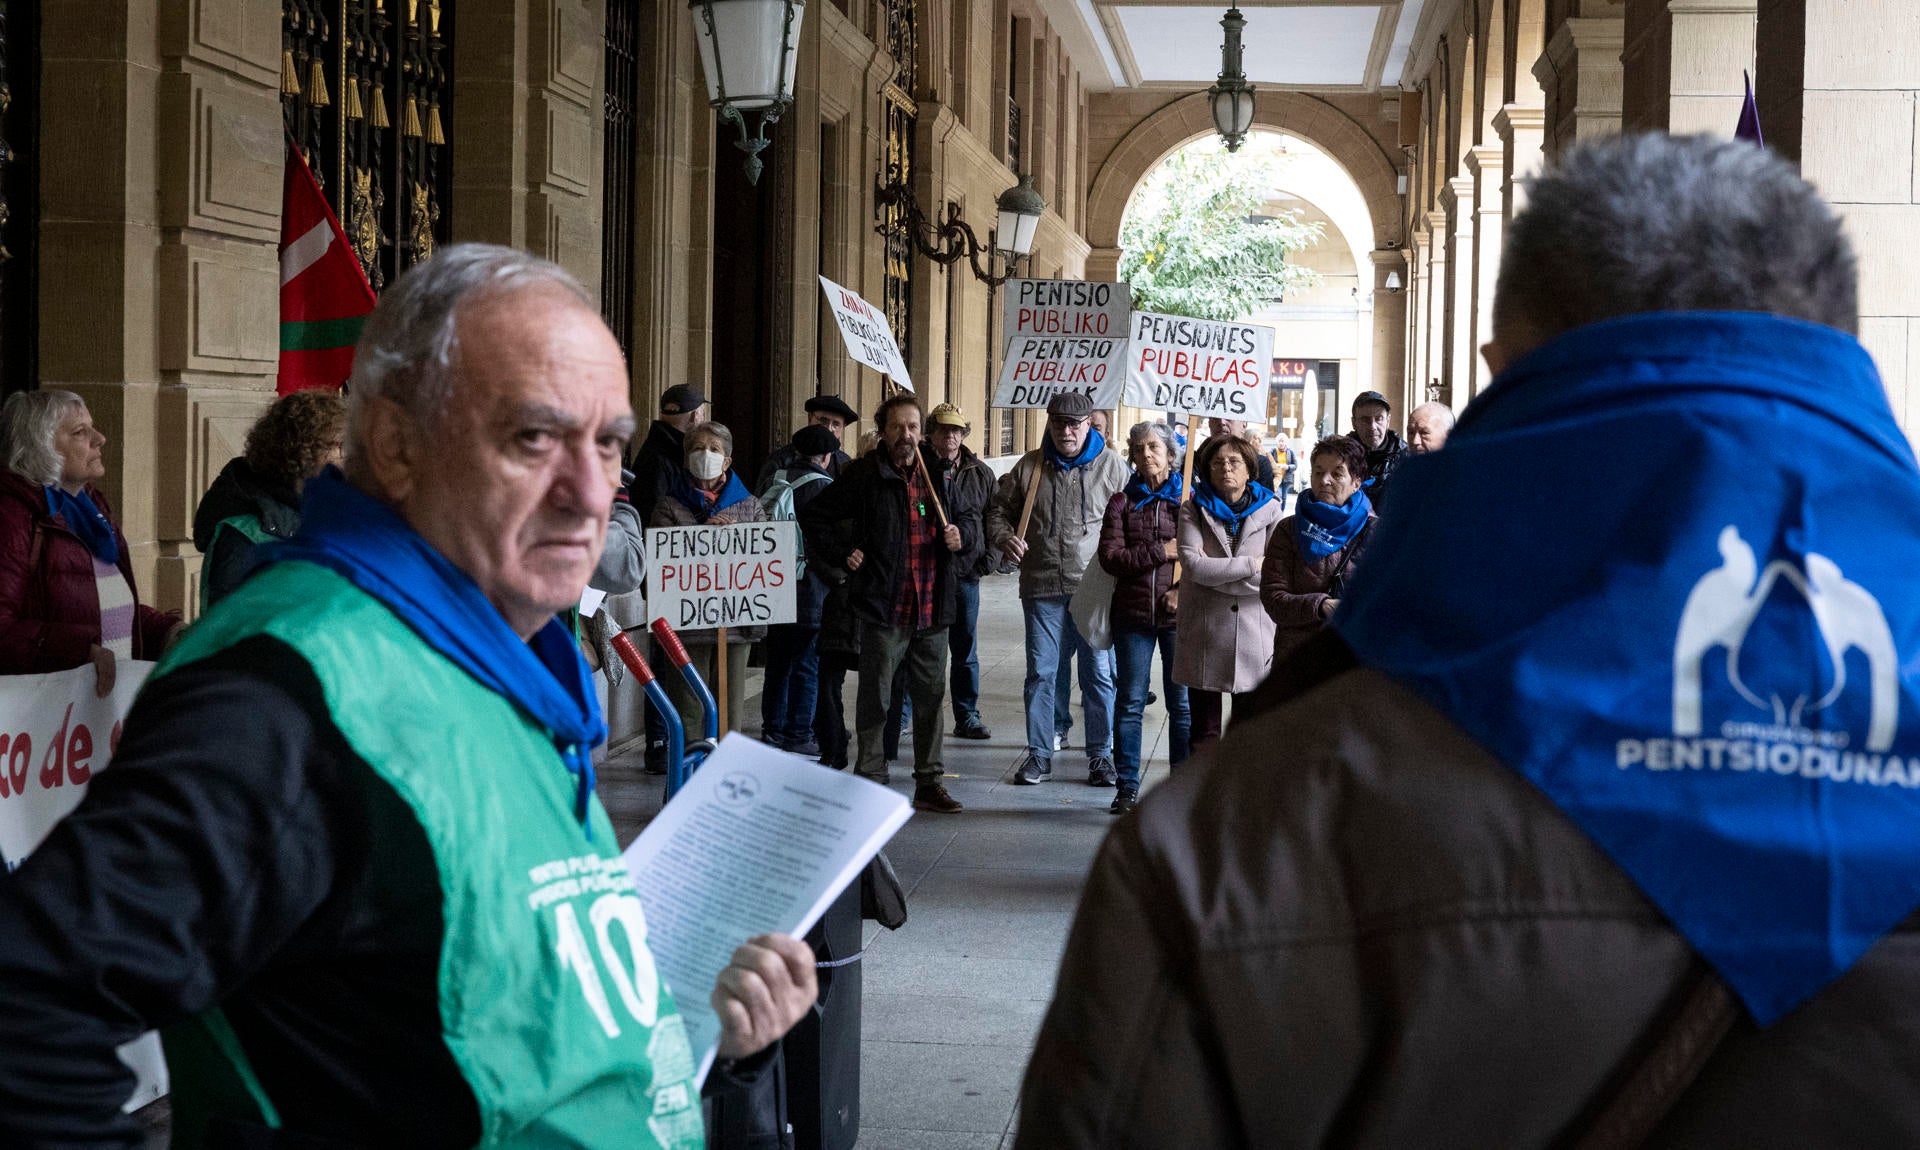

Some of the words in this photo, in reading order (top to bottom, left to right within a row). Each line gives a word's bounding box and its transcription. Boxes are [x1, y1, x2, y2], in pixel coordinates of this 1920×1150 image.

[1020, 281, 1110, 307] PENTSIO
[1017, 308, 1109, 335] PUBLIKO
[1137, 315, 1255, 355] PENSIONES
[1021, 339, 1113, 359] PENTSIO
[1013, 360, 1107, 383] PUBLIKO
[1139, 347, 1260, 388] PUBLICAS
[1154, 382, 1246, 414] DIGNAS
[656, 527, 777, 559] PENSIONES
[661, 560, 784, 592] PUBLICAS
[680, 594, 771, 627] DIGNAS
[39, 701, 93, 790] de
